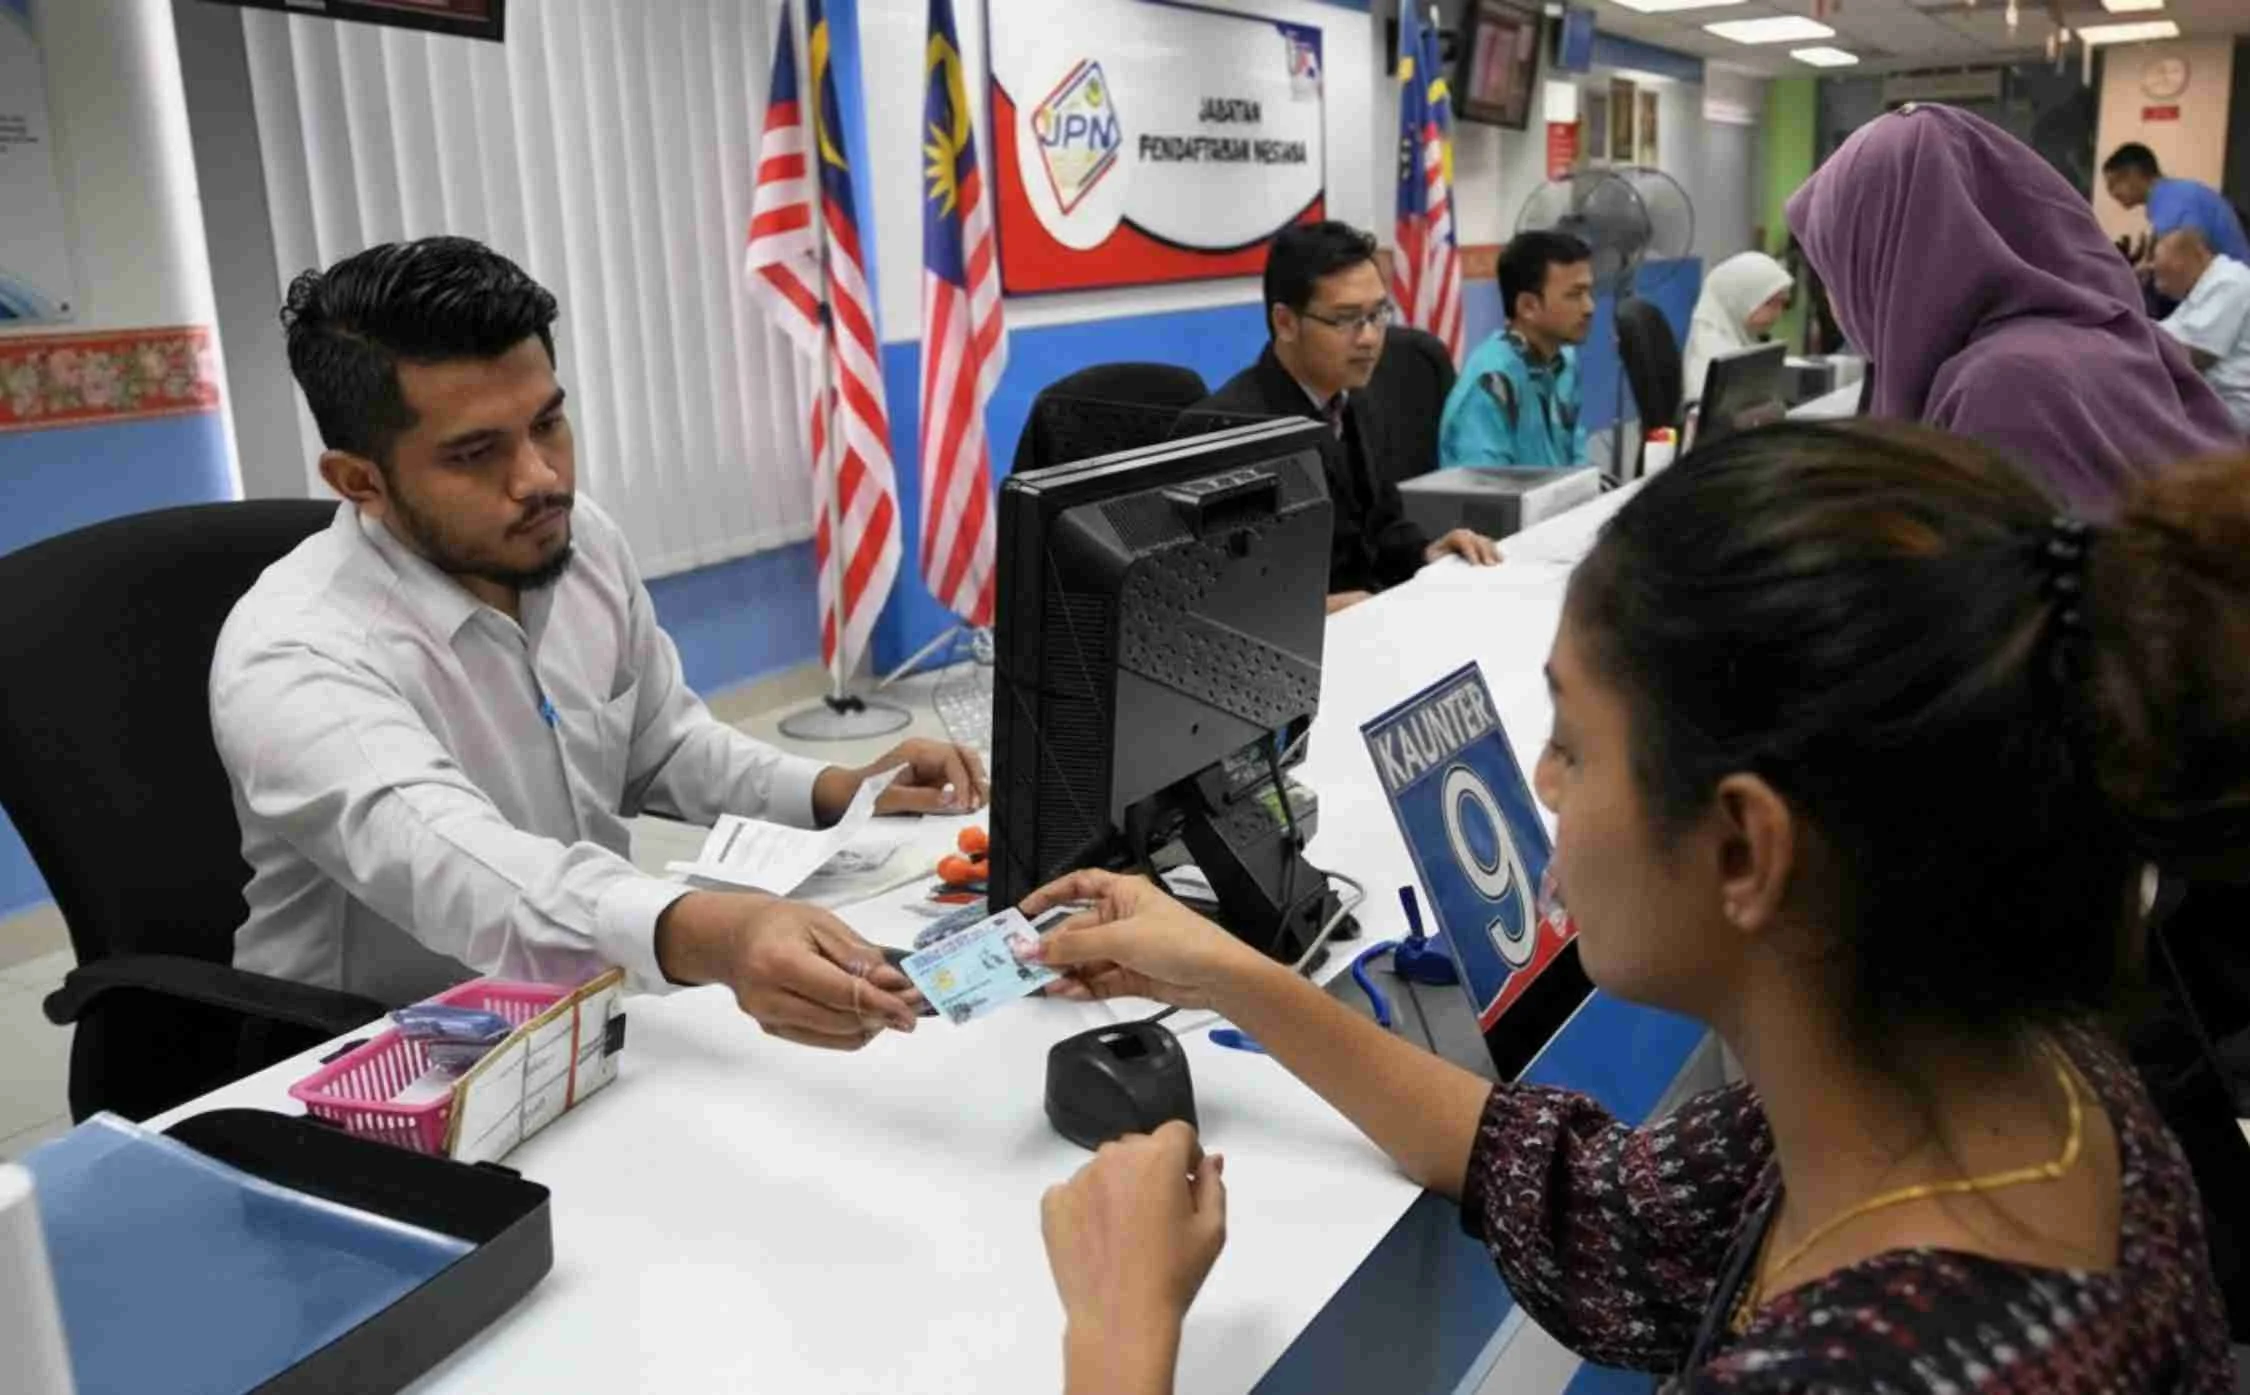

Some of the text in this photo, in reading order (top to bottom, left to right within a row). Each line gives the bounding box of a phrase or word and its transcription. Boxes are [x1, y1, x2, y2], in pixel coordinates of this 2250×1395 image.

[1038, 114, 1116, 151] JPN
[1375, 681, 1496, 792] KAUNTER
[1442, 763, 1538, 970] 9
